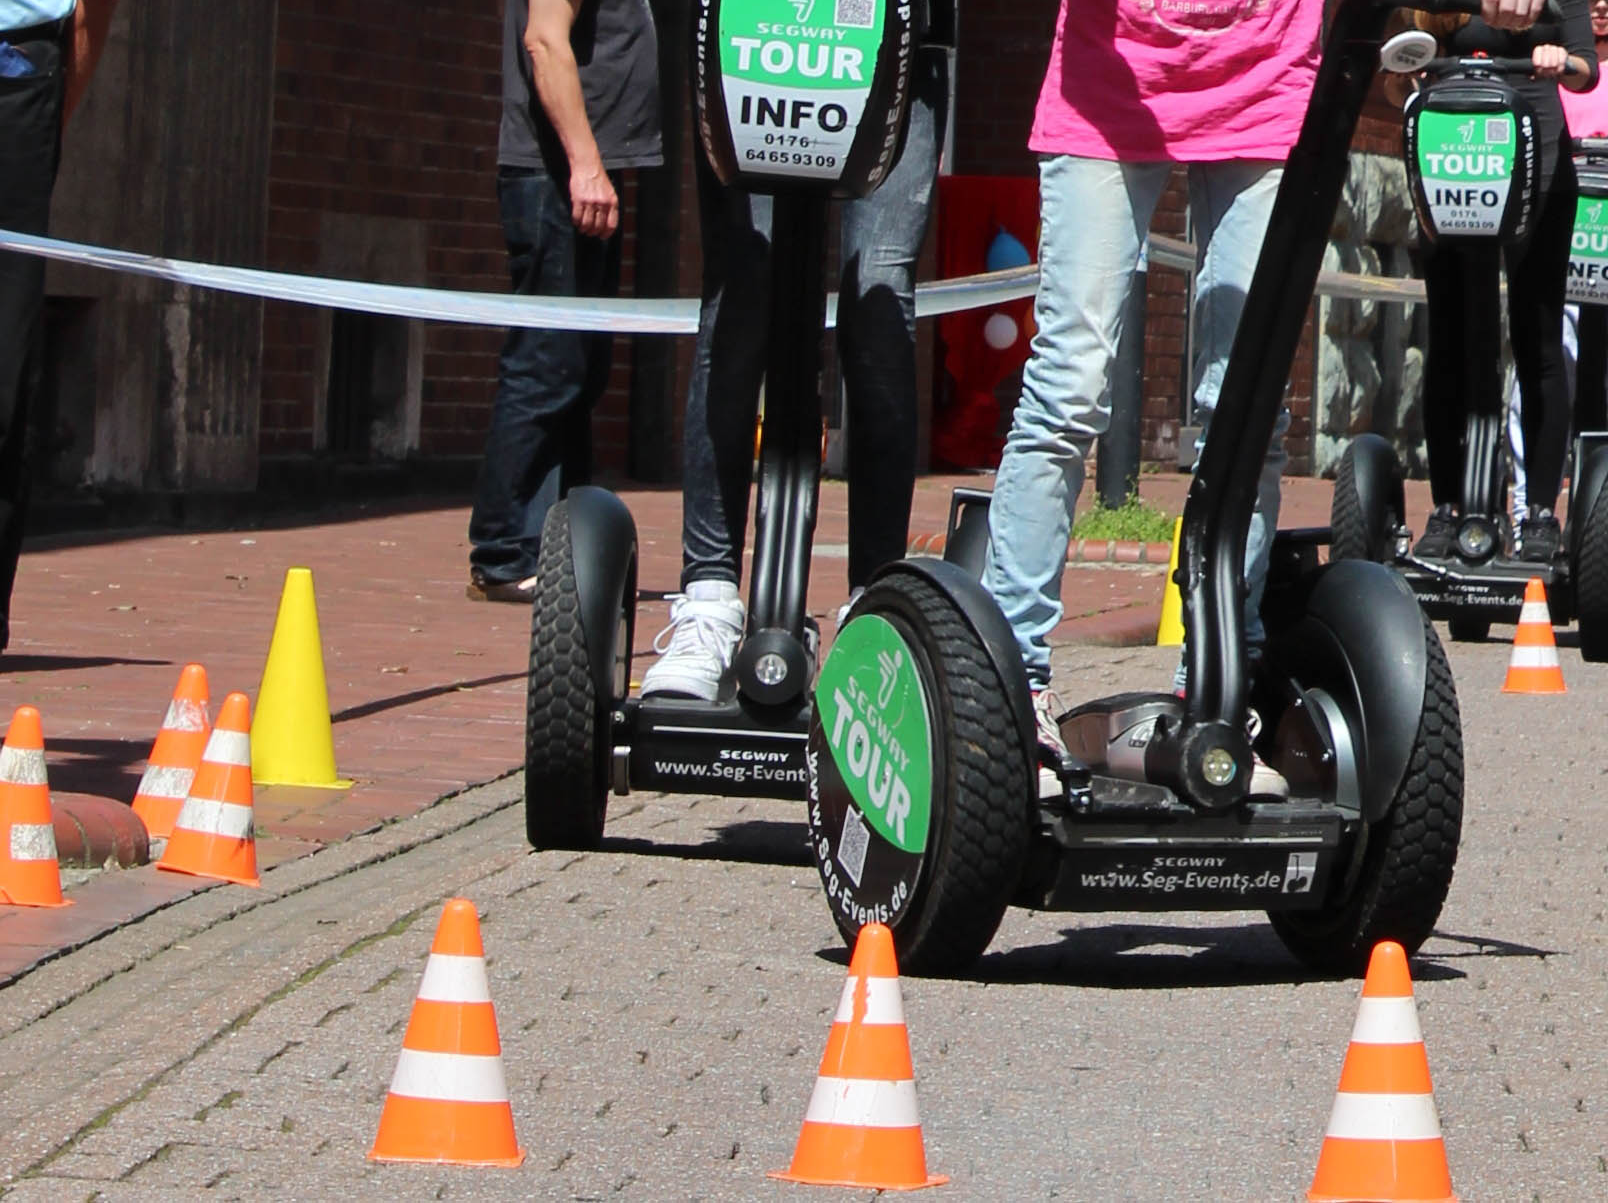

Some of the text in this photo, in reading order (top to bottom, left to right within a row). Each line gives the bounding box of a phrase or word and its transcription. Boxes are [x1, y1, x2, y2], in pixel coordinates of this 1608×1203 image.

[757, 22, 848, 41] SEGWAY
[730, 36, 864, 82] TOUR
[740, 95, 848, 133] INFO
[764, 133, 810, 148] 0176
[1440, 142, 1494, 152] SEGWAY
[1425, 153, 1505, 176] TOUR
[1435, 188, 1499, 207] INFO
[1450, 209, 1478, 218] 0176
[848, 675, 911, 773] SEGWAY
[719, 749, 790, 762] SEGWAY
[654, 761, 806, 783] www.Seg-Event
[831, 686, 912, 846] TOUR
[1153, 856, 1227, 868] SEGWAY
[1080, 870, 1281, 893] www.Seg-Events.de
